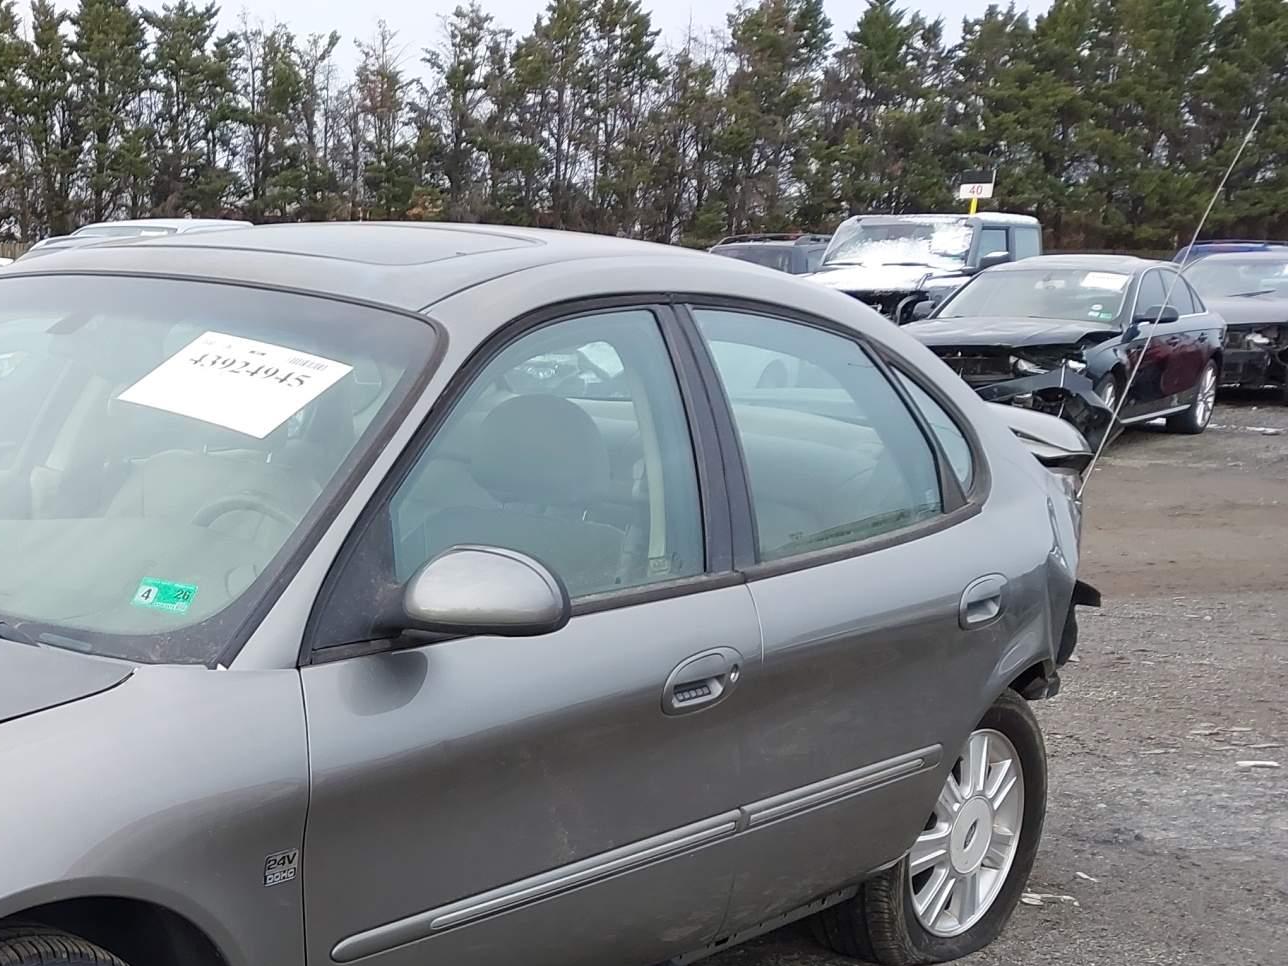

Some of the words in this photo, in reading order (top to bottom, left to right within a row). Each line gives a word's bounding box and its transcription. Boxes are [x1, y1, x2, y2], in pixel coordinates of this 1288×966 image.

[969, 185, 983, 195] 40
[189, 351, 312, 389] 43924945
[141, 588, 153, 600] 4
[175, 589, 192, 601] 26
[266, 852, 297, 870] 24V
